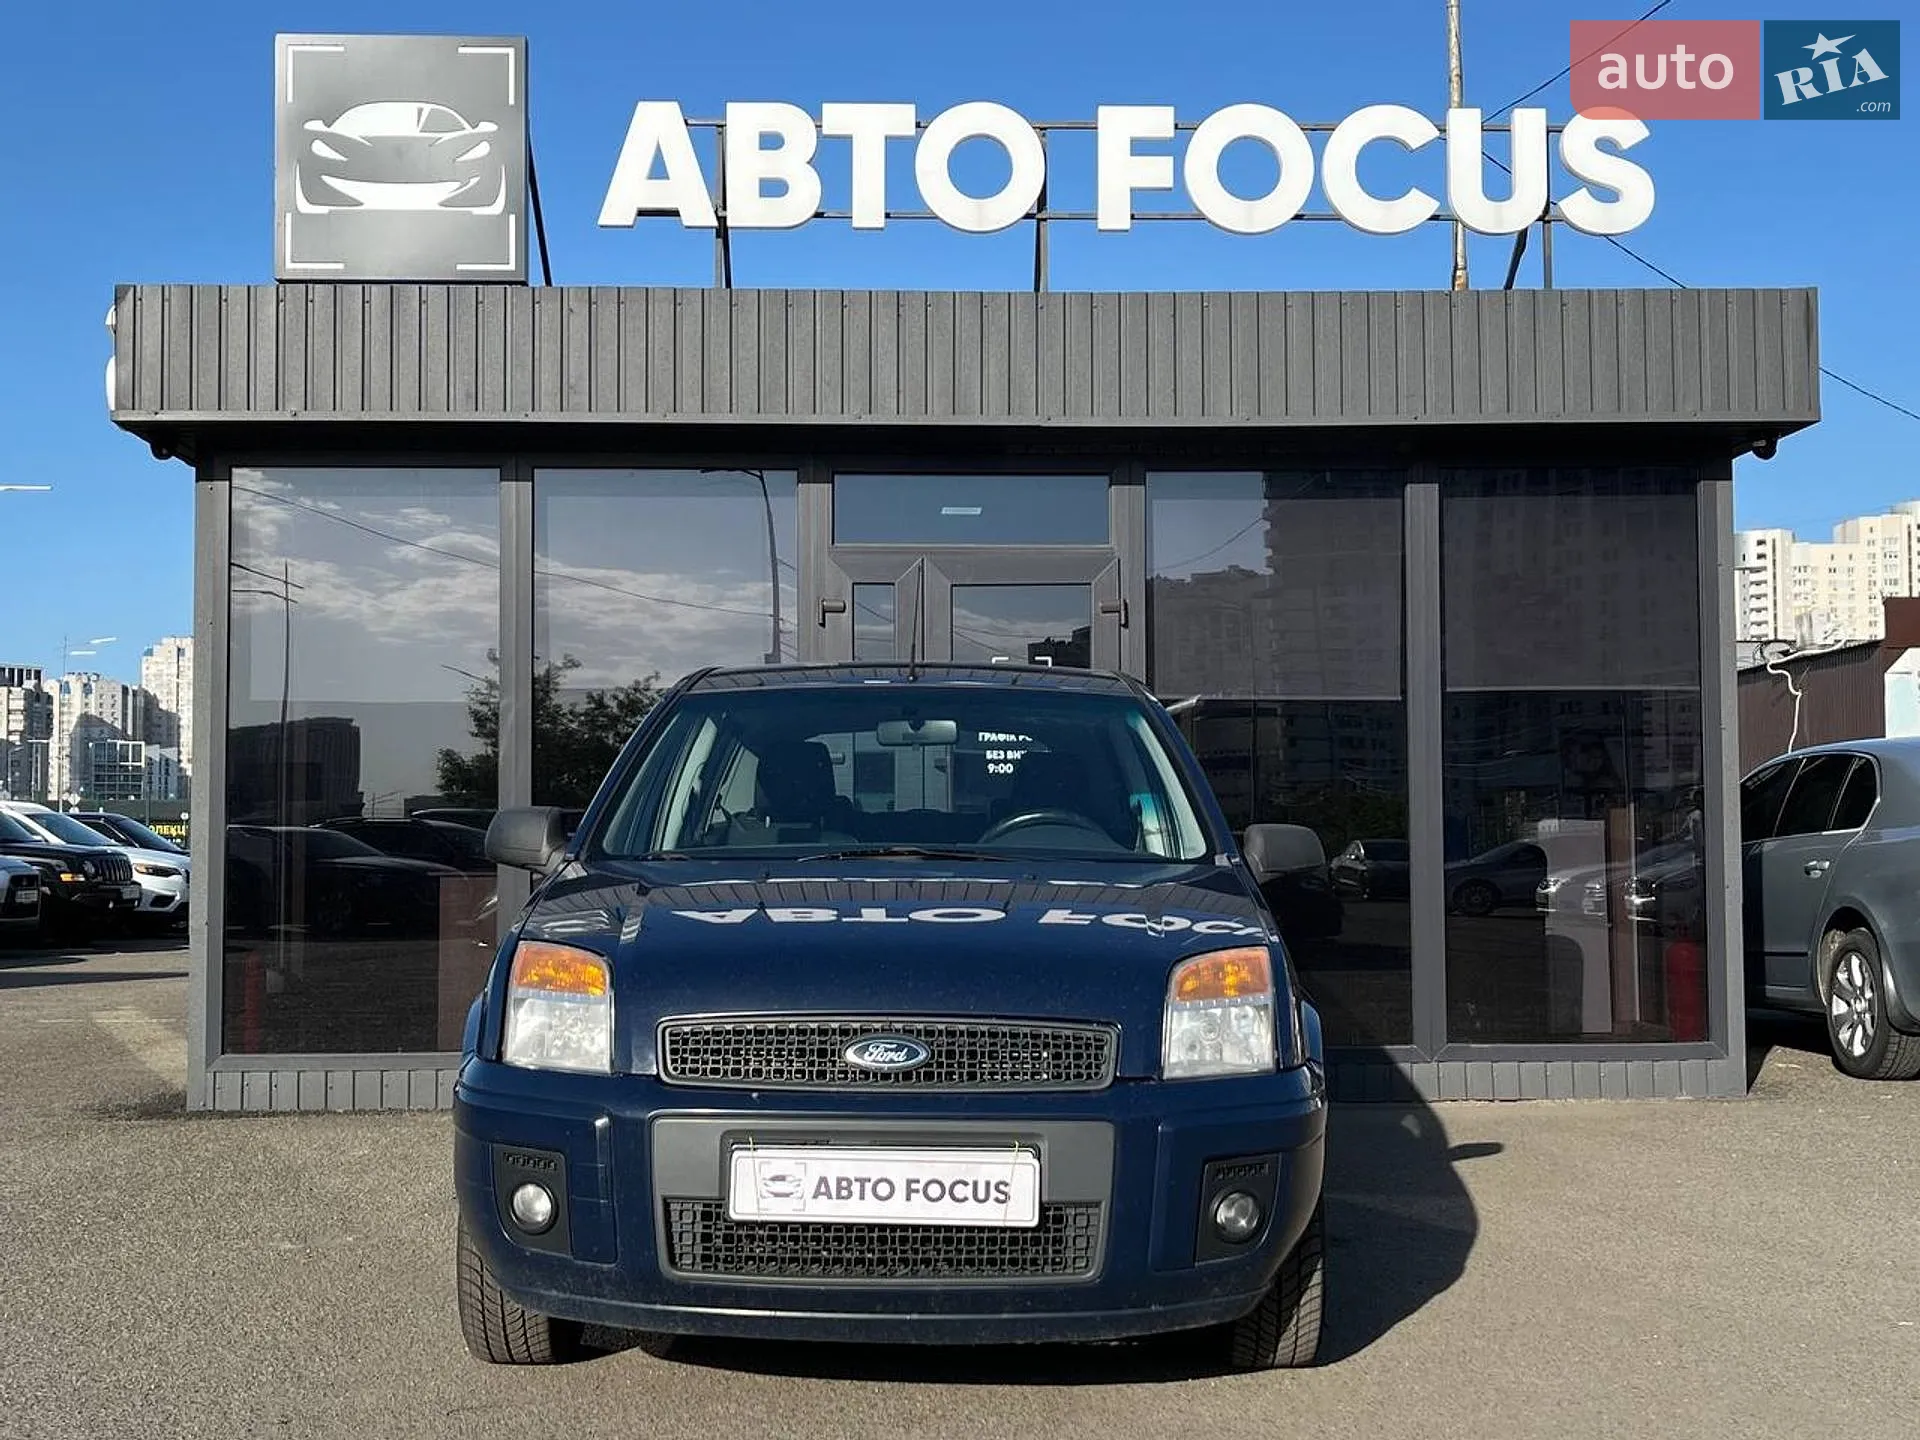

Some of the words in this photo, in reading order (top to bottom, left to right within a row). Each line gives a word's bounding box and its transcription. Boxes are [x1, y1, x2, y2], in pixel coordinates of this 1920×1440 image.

[597, 100, 1046, 232] АВТО
[1097, 103, 1656, 236] FOCUS
[987, 762, 1014, 774] 9:00
[863, 1042, 909, 1062] Ford
[812, 1175, 896, 1202] АВТО
[904, 1177, 1012, 1204] FOCUS
